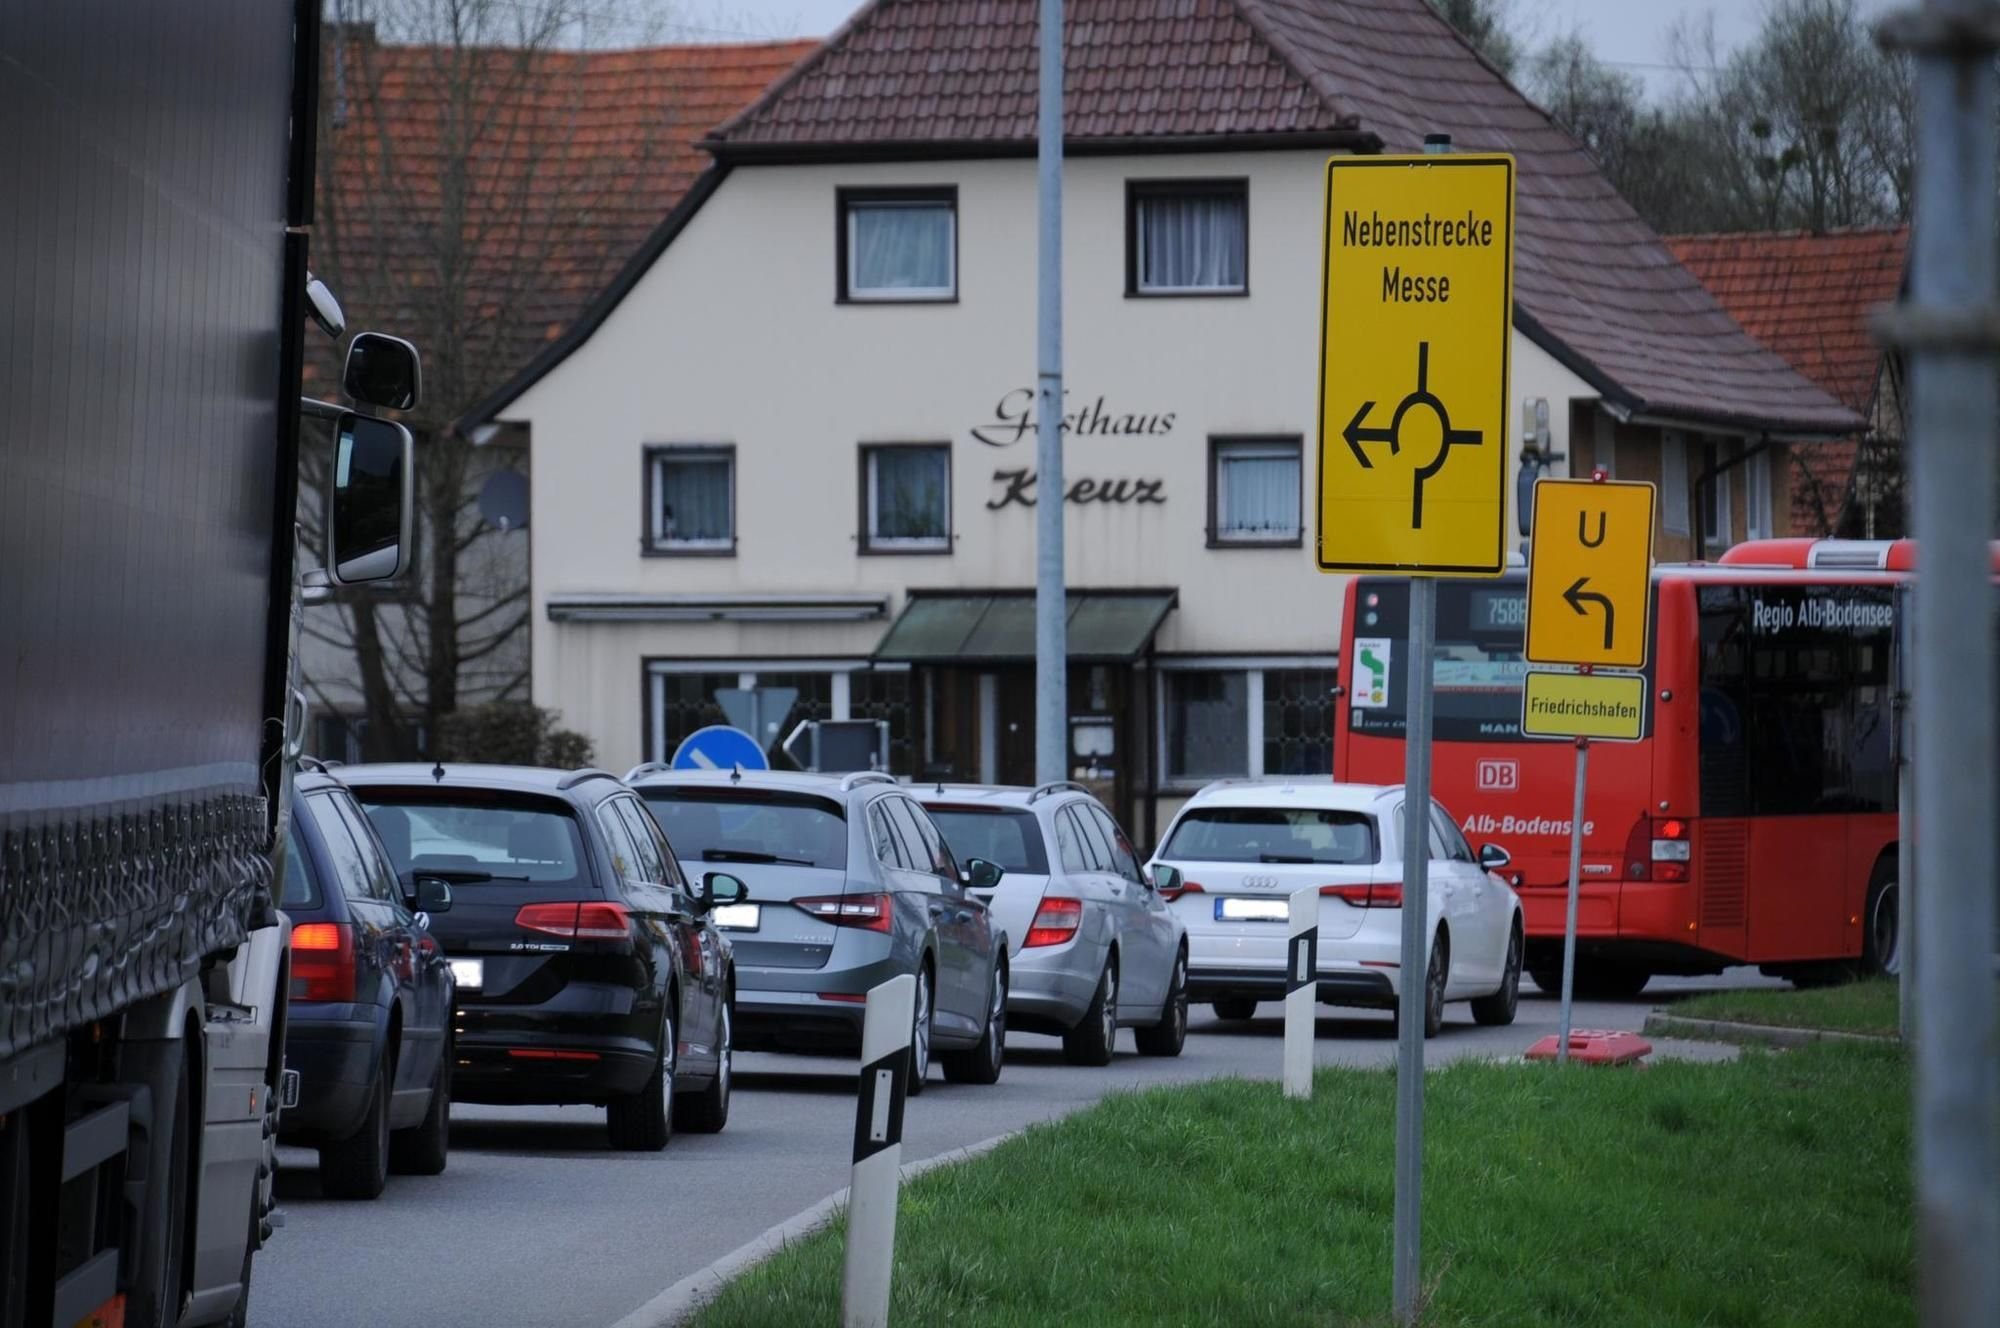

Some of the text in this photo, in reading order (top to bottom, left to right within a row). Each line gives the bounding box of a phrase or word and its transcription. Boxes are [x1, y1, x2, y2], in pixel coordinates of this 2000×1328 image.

[1343, 210, 1492, 247] Nebenstrecke
[1382, 267, 1450, 302] Messe
[970, 388, 1176, 447] Gsthaus
[986, 469, 1166, 509] Keuz
[1579, 511, 1606, 547] U
[1753, 599, 1793, 633] Regio
[1531, 697, 1637, 720] Friedrichshafen
[1480, 723, 1518, 734] MAN
[1481, 765, 1514, 787] DB
[1462, 815, 1594, 836] Alb-Bodense
